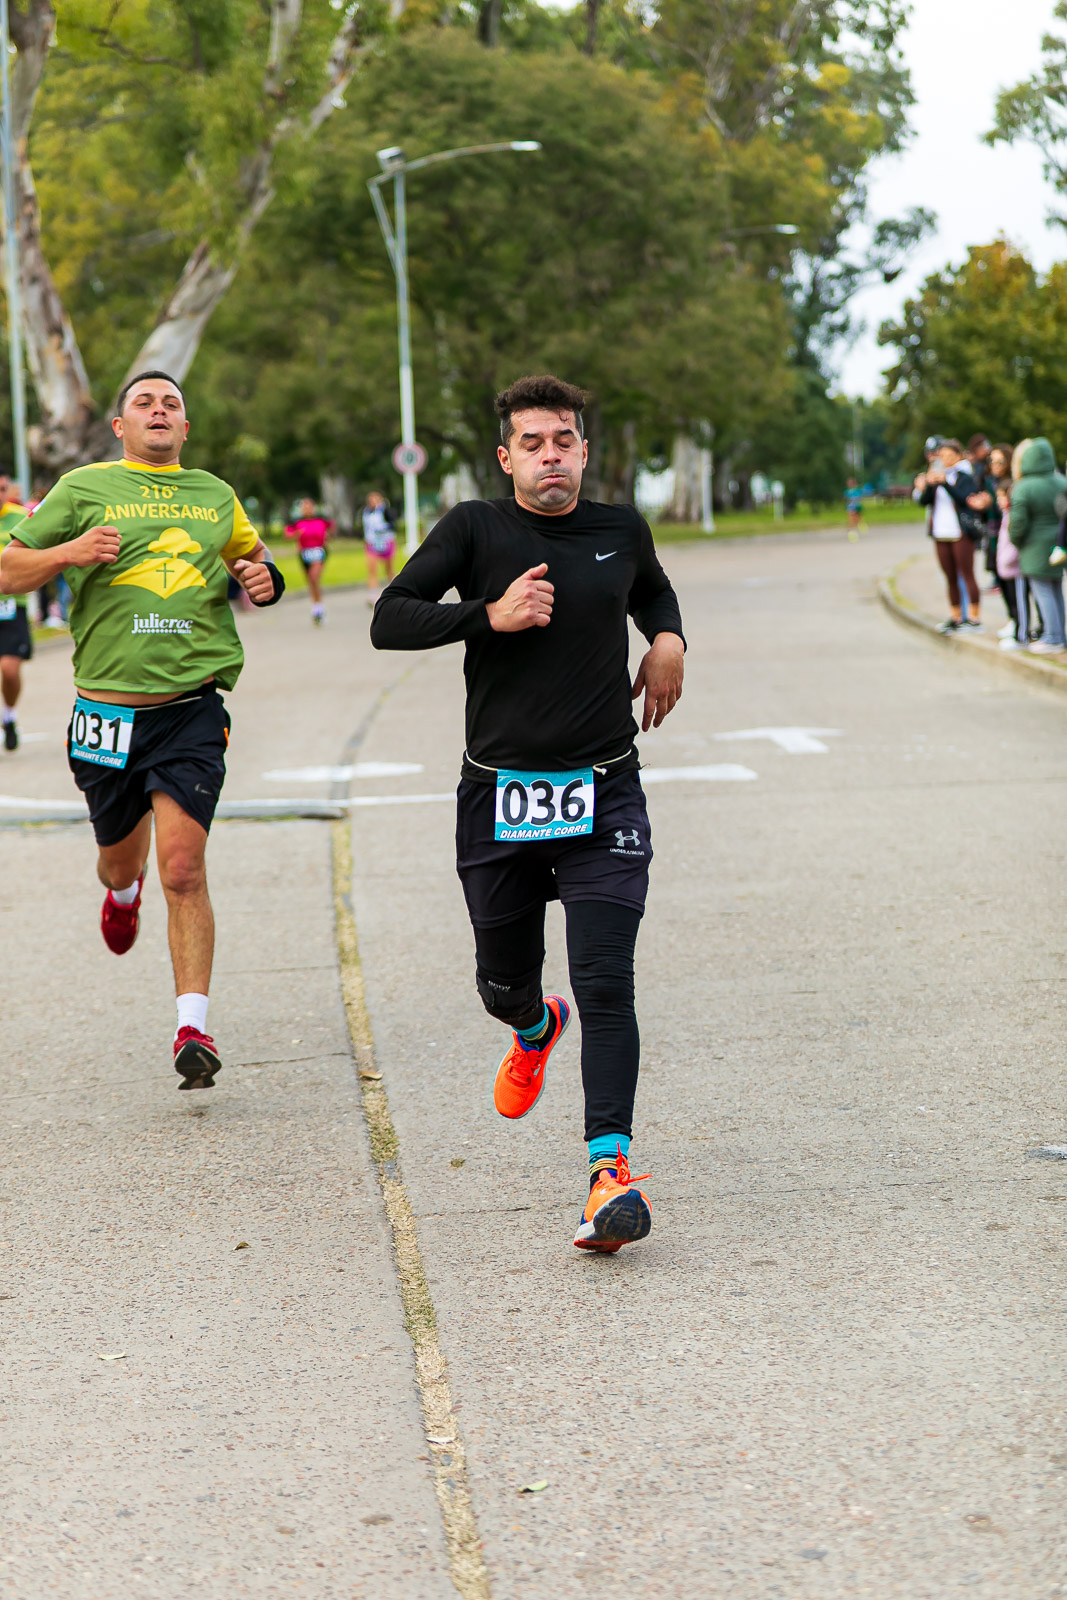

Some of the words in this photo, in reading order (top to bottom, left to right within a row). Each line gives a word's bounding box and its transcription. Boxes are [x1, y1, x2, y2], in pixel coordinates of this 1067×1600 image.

[104, 503, 219, 523] ANIVERSARIO
[131, 612, 194, 635] julicroc
[75, 707, 122, 755] 031
[100, 755, 123, 767] CORRE
[502, 778, 586, 827] 036
[500, 828, 552, 839] DIAMANTE
[554, 823, 588, 836] CORRE
